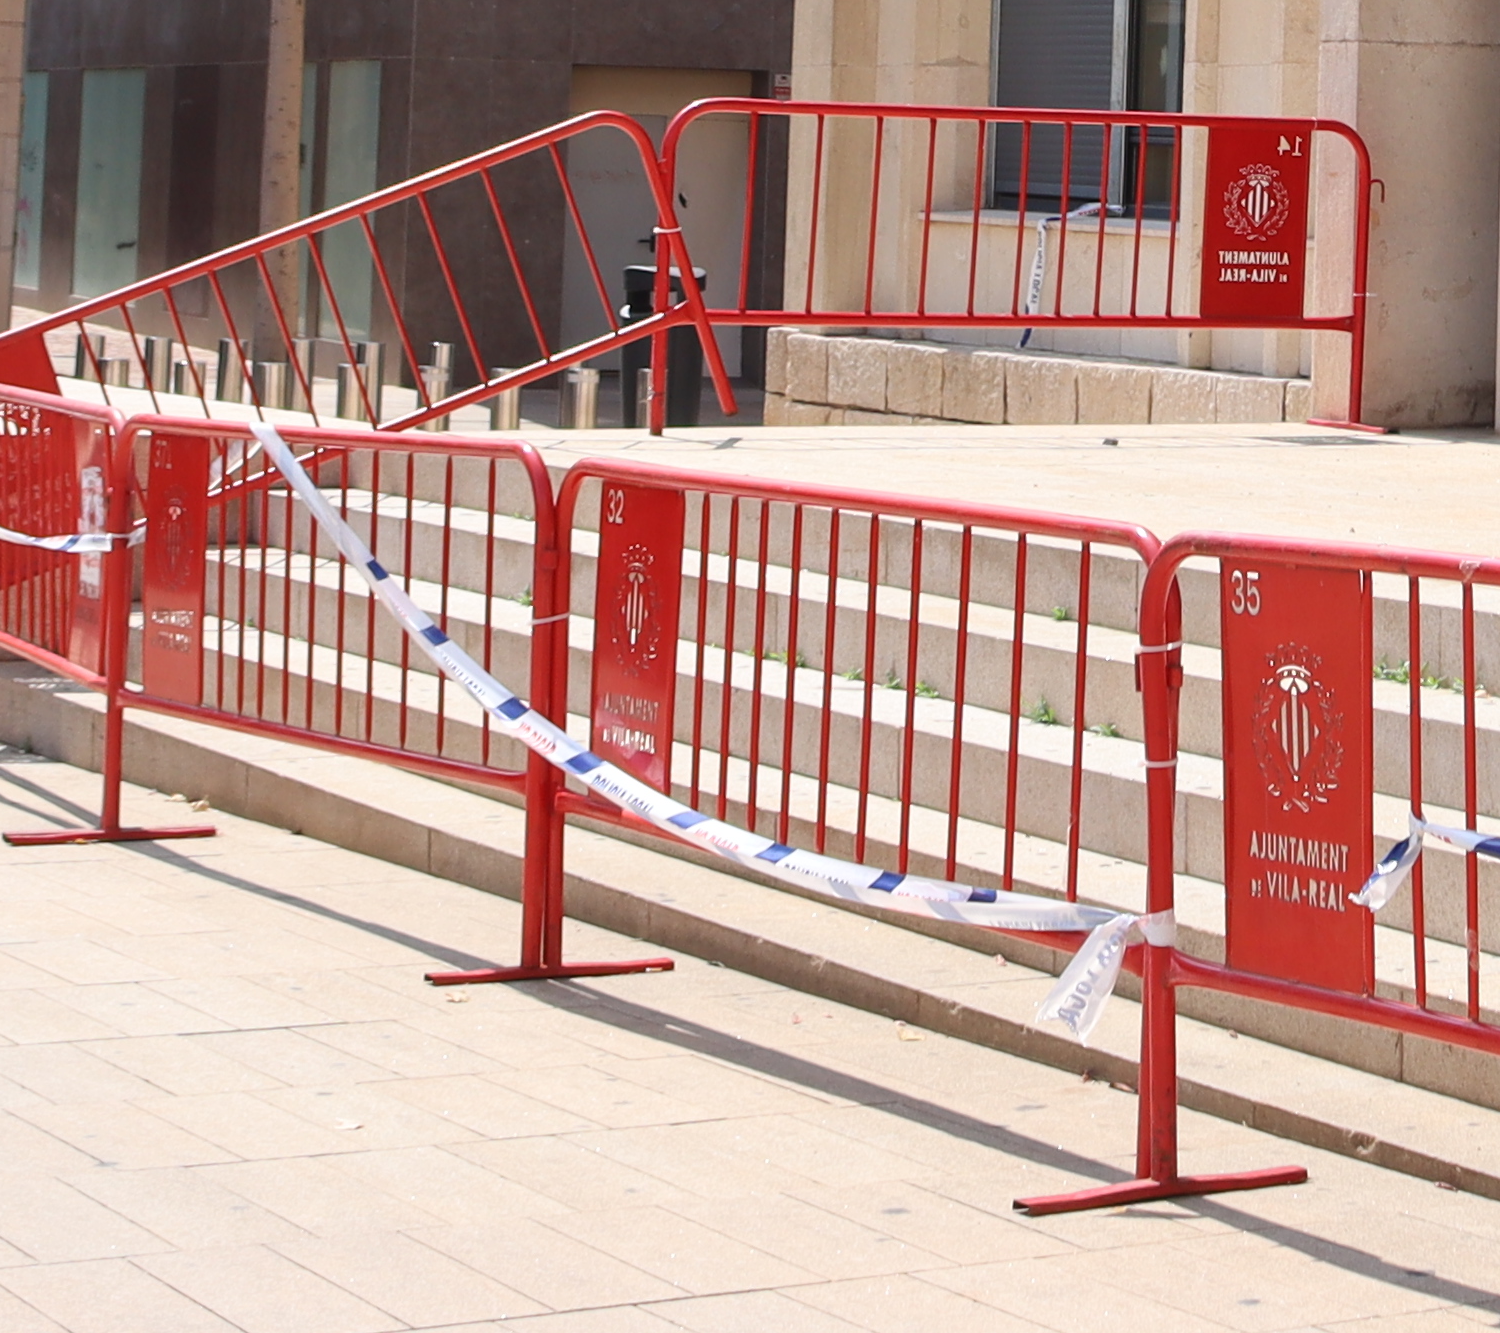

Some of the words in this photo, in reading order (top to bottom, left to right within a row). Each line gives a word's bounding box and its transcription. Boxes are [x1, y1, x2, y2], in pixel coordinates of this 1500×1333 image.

[607, 488, 625, 525] 32
[1231, 569, 1261, 616] 35
[1249, 829, 1349, 873] AJUNTAMENT
[1266, 870, 1346, 913] VILA-REAL
